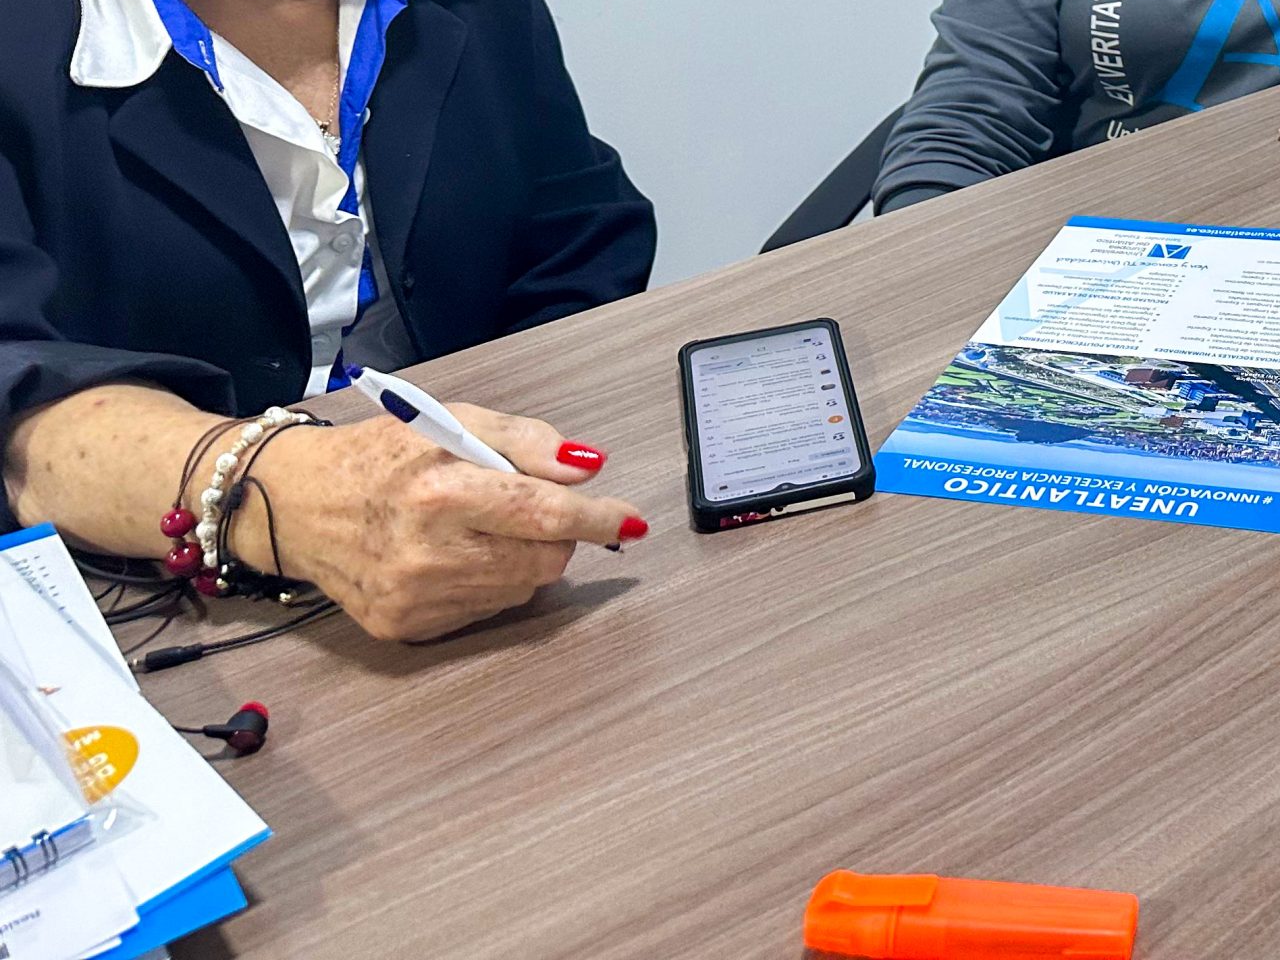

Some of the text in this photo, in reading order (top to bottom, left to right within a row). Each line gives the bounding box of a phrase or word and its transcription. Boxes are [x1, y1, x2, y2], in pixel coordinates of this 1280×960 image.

[1090, 248, 1144, 257] Universidad
[1108, 244, 1146, 252] Europea
[1056, 256, 1121, 266] Universidad
[1088, 293, 1121, 301] CIENCIAS
[1133, 296, 1169, 305] FACULTAD
[1017, 335, 1055, 344] SUPERIOR
[1056, 339, 1105, 348] POLITÉCNICA
[1154, 348, 1210, 357] HUMANIDADES
[1218, 353, 1254, 361] SOCIALES
[902, 457, 1018, 480] PROFESIONAL
[1021, 471, 1124, 491] EXCELENCIA
[1125, 482, 1139, 492] Y
[943, 476, 1200, 518] UNEATLANTICO
[1145, 483, 1260, 505] INNOVACIÓN
